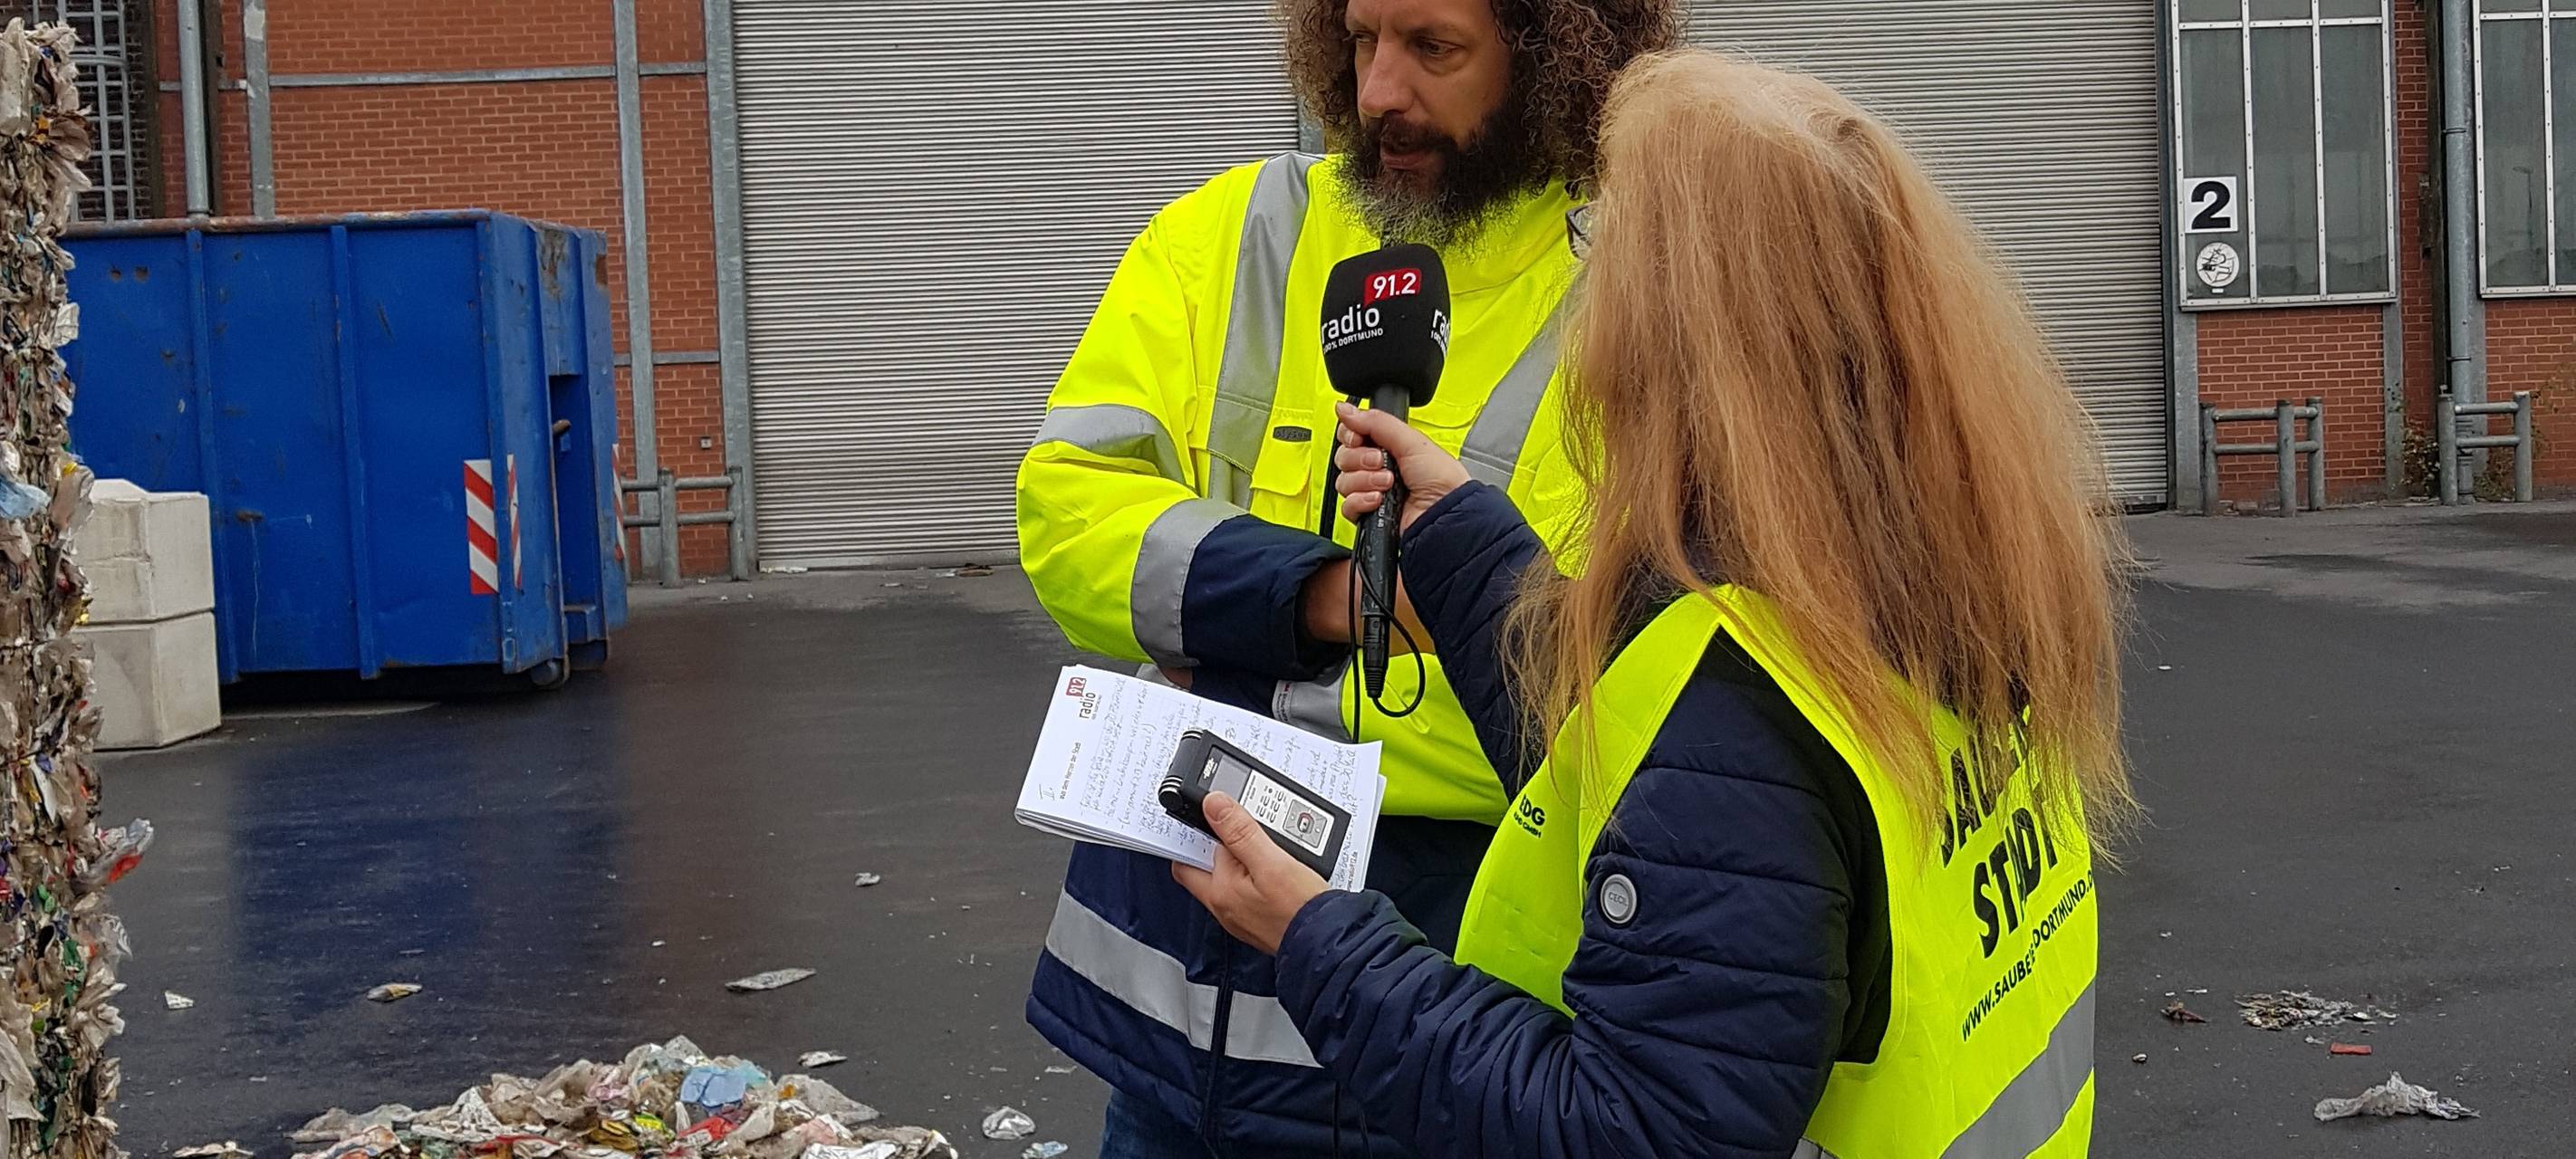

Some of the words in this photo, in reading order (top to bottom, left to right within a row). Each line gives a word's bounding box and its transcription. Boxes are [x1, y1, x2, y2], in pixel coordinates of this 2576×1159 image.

[2191, 180, 2231, 230] 2
[1373, 272, 1417, 299] 91.2
[1321, 303, 1380, 345] radio
[1338, 328, 1384, 347] DORTMUND
[1079, 692, 1096, 719] radio
